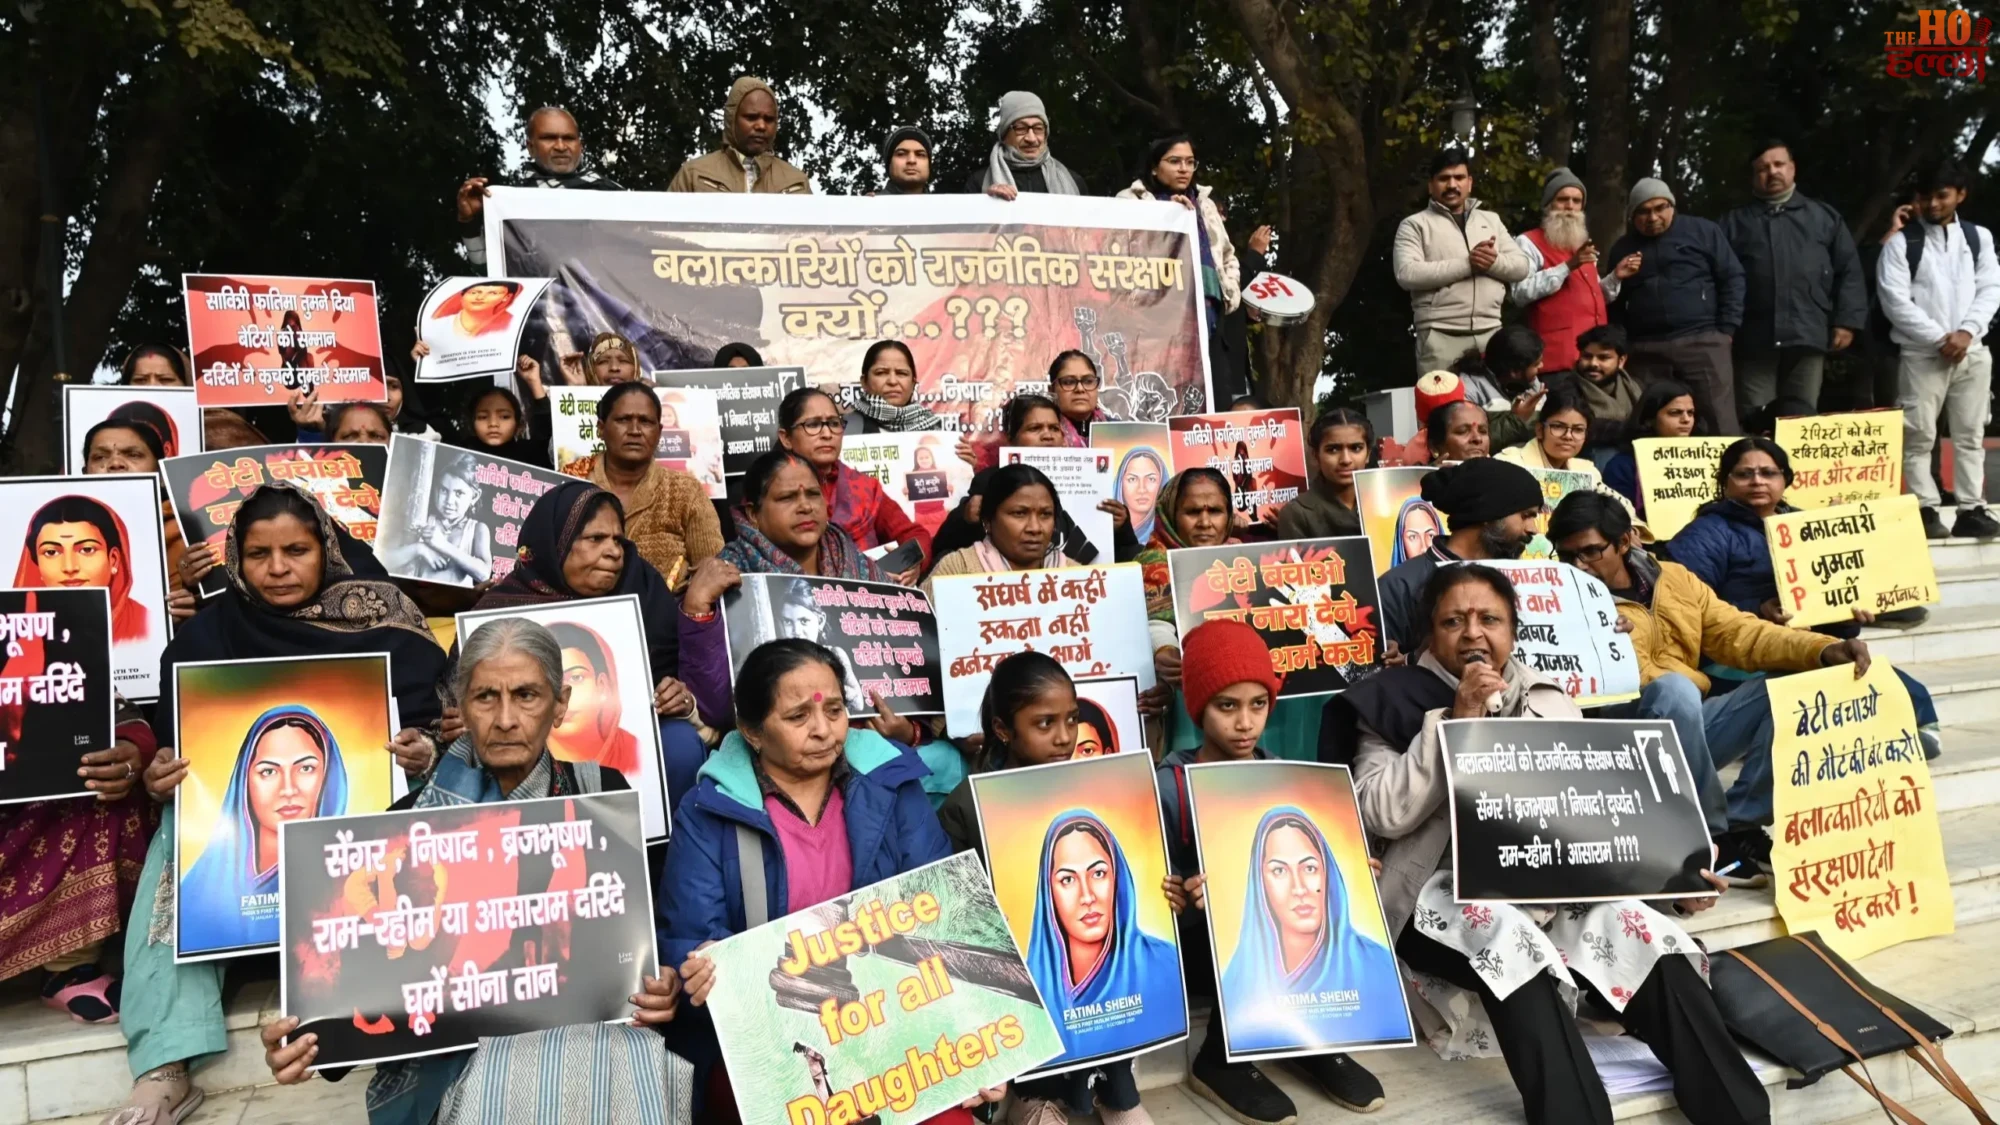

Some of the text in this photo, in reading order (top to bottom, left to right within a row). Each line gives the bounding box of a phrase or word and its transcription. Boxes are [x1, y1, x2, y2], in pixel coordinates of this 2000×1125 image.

[651, 235, 1184, 291] बलात्कारियों को राजनैतिक संरक्षण
[204, 285, 355, 320] सावित्री फातिमा तुमने दिया
[1249, 278, 1294, 299] SFI
[237, 324, 336, 348] बेटियों को सम्मान
[202, 361, 370, 394] दरिंदों ने कुचले तुम्हारे अरमान
[559, 393, 575, 416] बेटी
[579, 419, 593, 440] देने
[1183, 418, 1287, 448] सावित्री फातिमा तुमने दिया
[1847, 421, 1861, 437] को
[870, 446, 881, 460] का
[882, 445, 899, 461] नारा
[1231, 454, 1274, 475] को सम्मान
[1851, 440, 1865, 456] को
[205, 453, 364, 490] बेटी बचाओ
[475, 463, 510, 488] सावित्री
[881, 464, 890, 484] से
[1792, 469, 1821, 490] अब
[1823, 460, 1856, 486] और
[332, 482, 380, 514] देने
[492, 492, 522, 519] बेटियों
[1270, 486, 1299, 504] अरमान
[1776, 523, 1793, 549] B
[1800, 503, 1876, 542] बलात्कारी
[1205, 551, 1346, 594] बेटी बचाओ
[1786, 558, 1798, 584] J
[1811, 549, 1865, 585] जुमला
[973, 568, 1108, 611] संघर्ष में कहीं
[1527, 589, 1562, 615] वाले
[1790, 586, 1807, 611] P
[840, 612, 922, 637] बेटियों को सम्मान
[1048, 604, 1091, 637] नहीं
[1251, 591, 1358, 631] नारा देने
[883, 644, 895, 665] ने
[894, 642, 925, 674] कुचले
[1270, 630, 1375, 673] शर्म करो
[29, 662, 86, 704] दरिंदे
[1793, 684, 1883, 737] बेटी बचाओ
[1455, 742, 1632, 775] बलात्कारियों को राजनैतिक संरक्षण क्यों
[1791, 751, 1811, 787] की
[1817, 737, 1868, 782] नौटंकी
[1475, 791, 1505, 821] सेंगर
[1513, 795, 1560, 829] ब्रजभूषण
[1560, 791, 1568, 817] ?
[1605, 787, 1633, 827] दुष्यंत
[1634, 789, 1644, 814] ?
[1785, 775, 1925, 847] बलात्कारियों को
[324, 817, 593, 880] सेंगर निषाद ब्रजभूषण
[1498, 835, 1641, 869] राम-रहीम ? आसाराम ????
[1789, 838, 1896, 902] संरक्षण देना
[312, 870, 626, 953] राम-रहीम या आसाराम दरिंदे
[1834, 891, 1866, 933] बंद
[1866, 880, 1902, 920] करो
[780, 891, 941, 979] Justice
[401, 960, 559, 1038] घूमें सीना तान
[818, 953, 954, 1046] for all
[1063, 993, 1142, 1021] FATIMA SHEIKH
[1320, 990, 1359, 1003] SHEIKH
[785, 1014, 1025, 1125] Daughters
